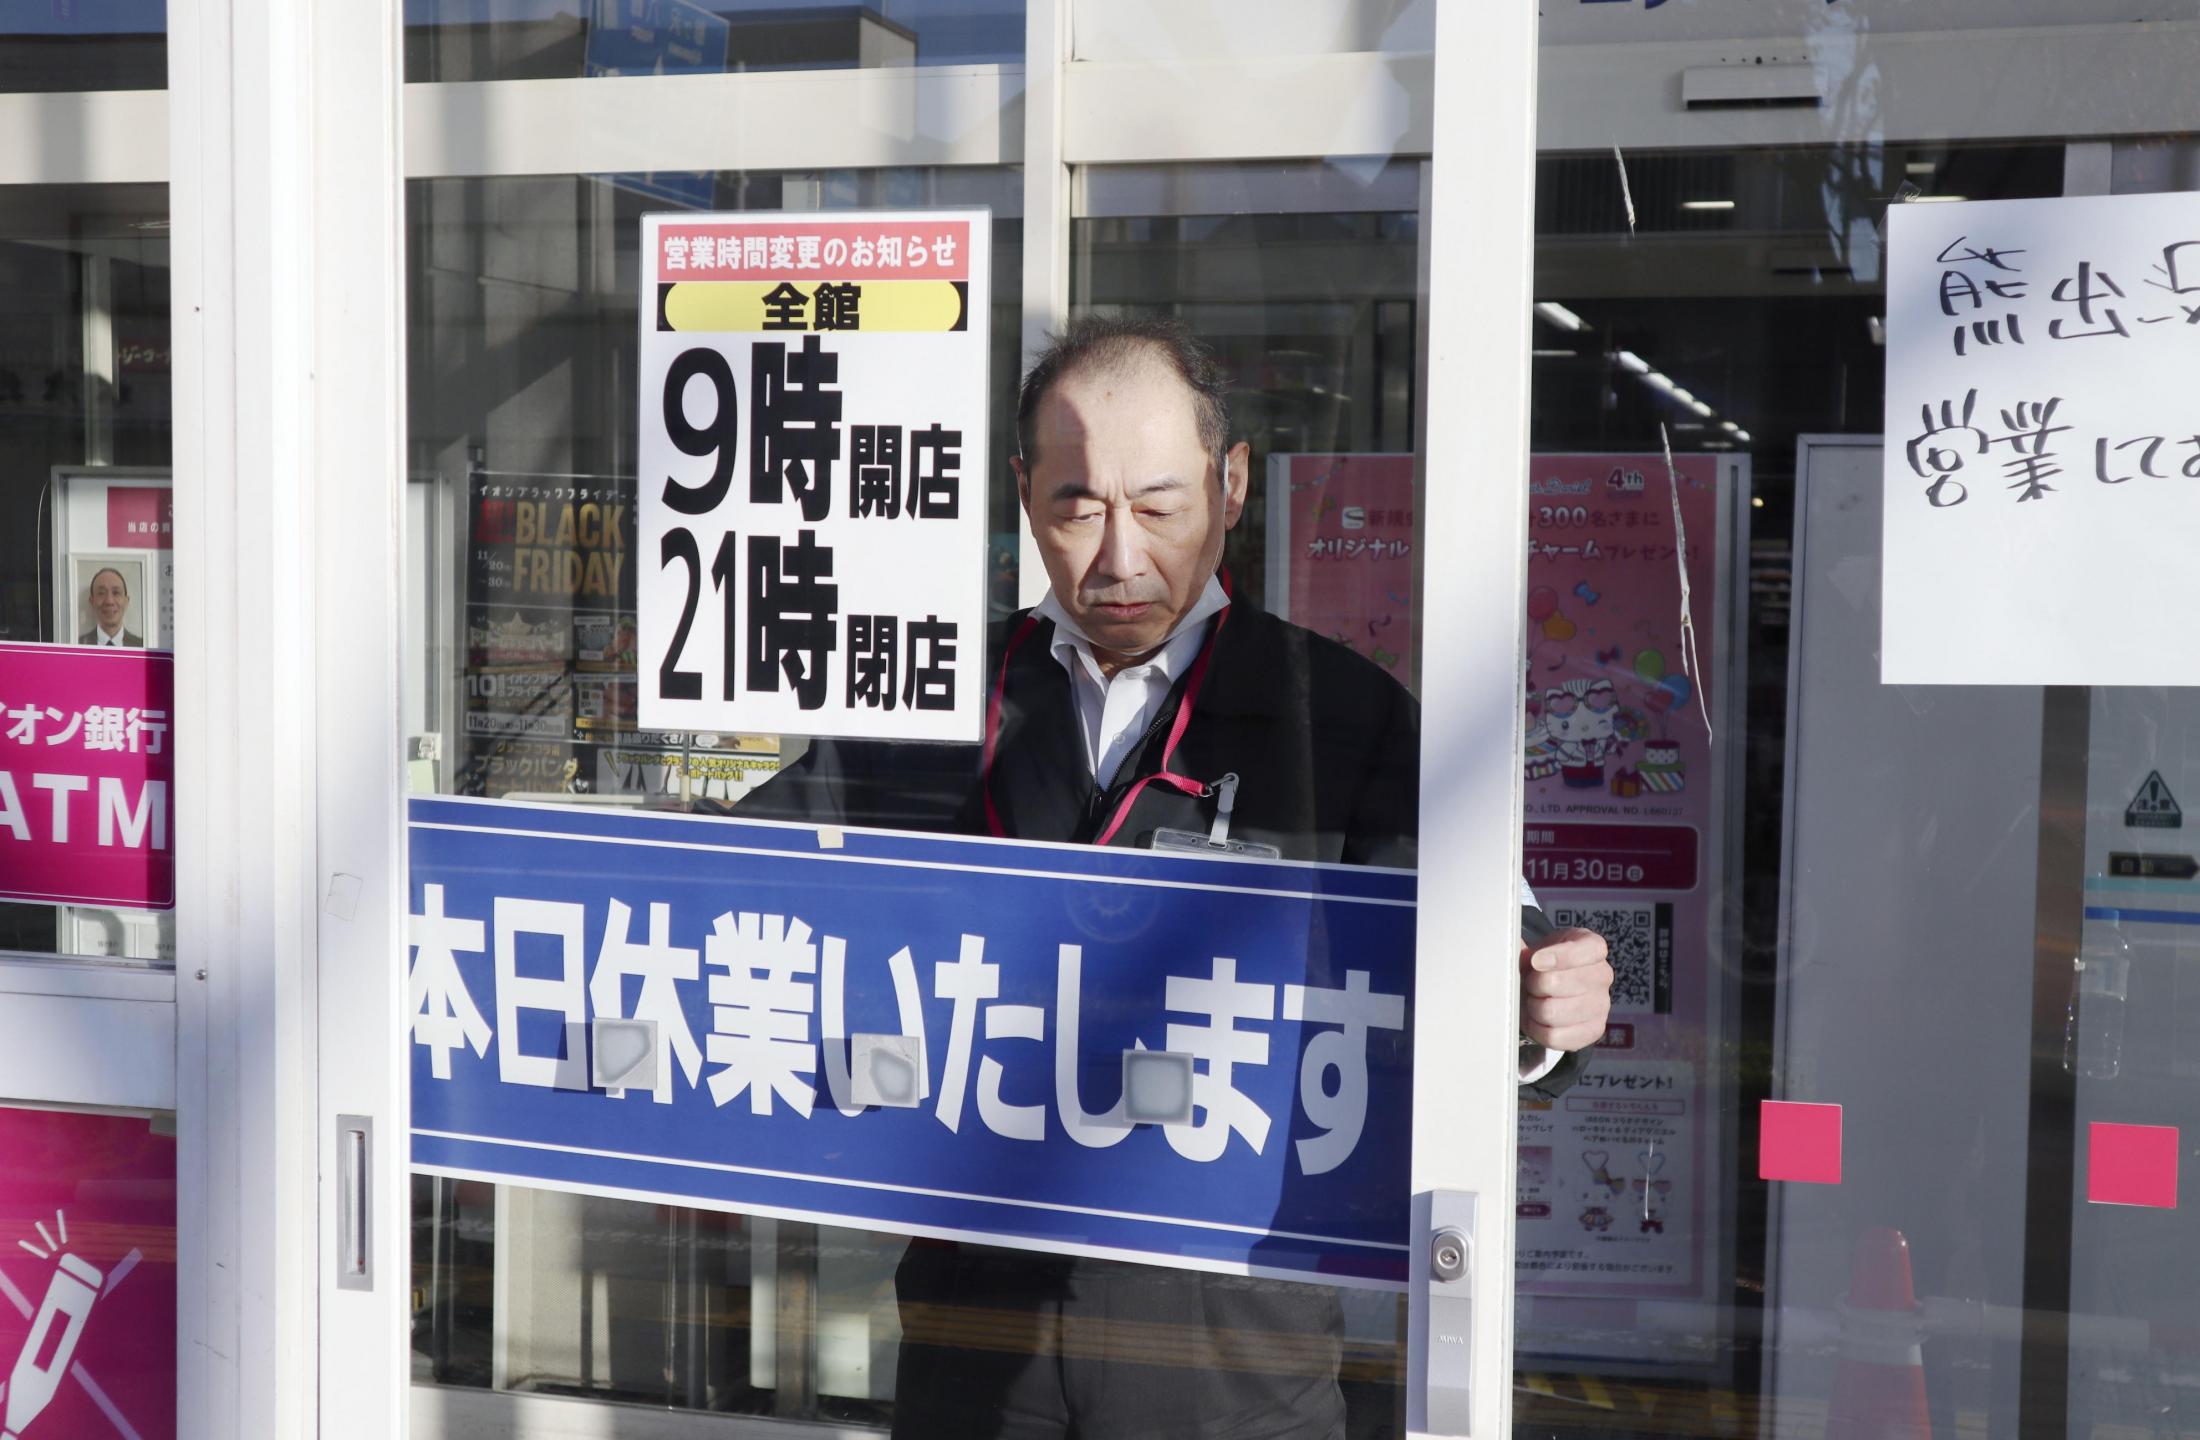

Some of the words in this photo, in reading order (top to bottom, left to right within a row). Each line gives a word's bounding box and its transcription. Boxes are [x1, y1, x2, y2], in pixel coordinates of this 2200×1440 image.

[664, 235, 957, 270] 営業時間変更のお知らせ
[762, 282, 861, 331] 全館
[661, 335, 962, 522] 9時開店
[1608, 467, 1645, 490] 4th
[515, 501, 625, 548] BLACK
[1527, 505, 1661, 528] 300名さまに
[512, 547, 625, 595] FRIDAY
[1307, 538, 1411, 560] オリジナル
[659, 526, 959, 711] 21時閉店
[0, 771, 167, 850] ATM
[1566, 804, 1619, 815] APPROVAL
[410, 884, 1405, 1176] 本日休業いたします
[1578, 1073, 1673, 1090] にプレゼント!
